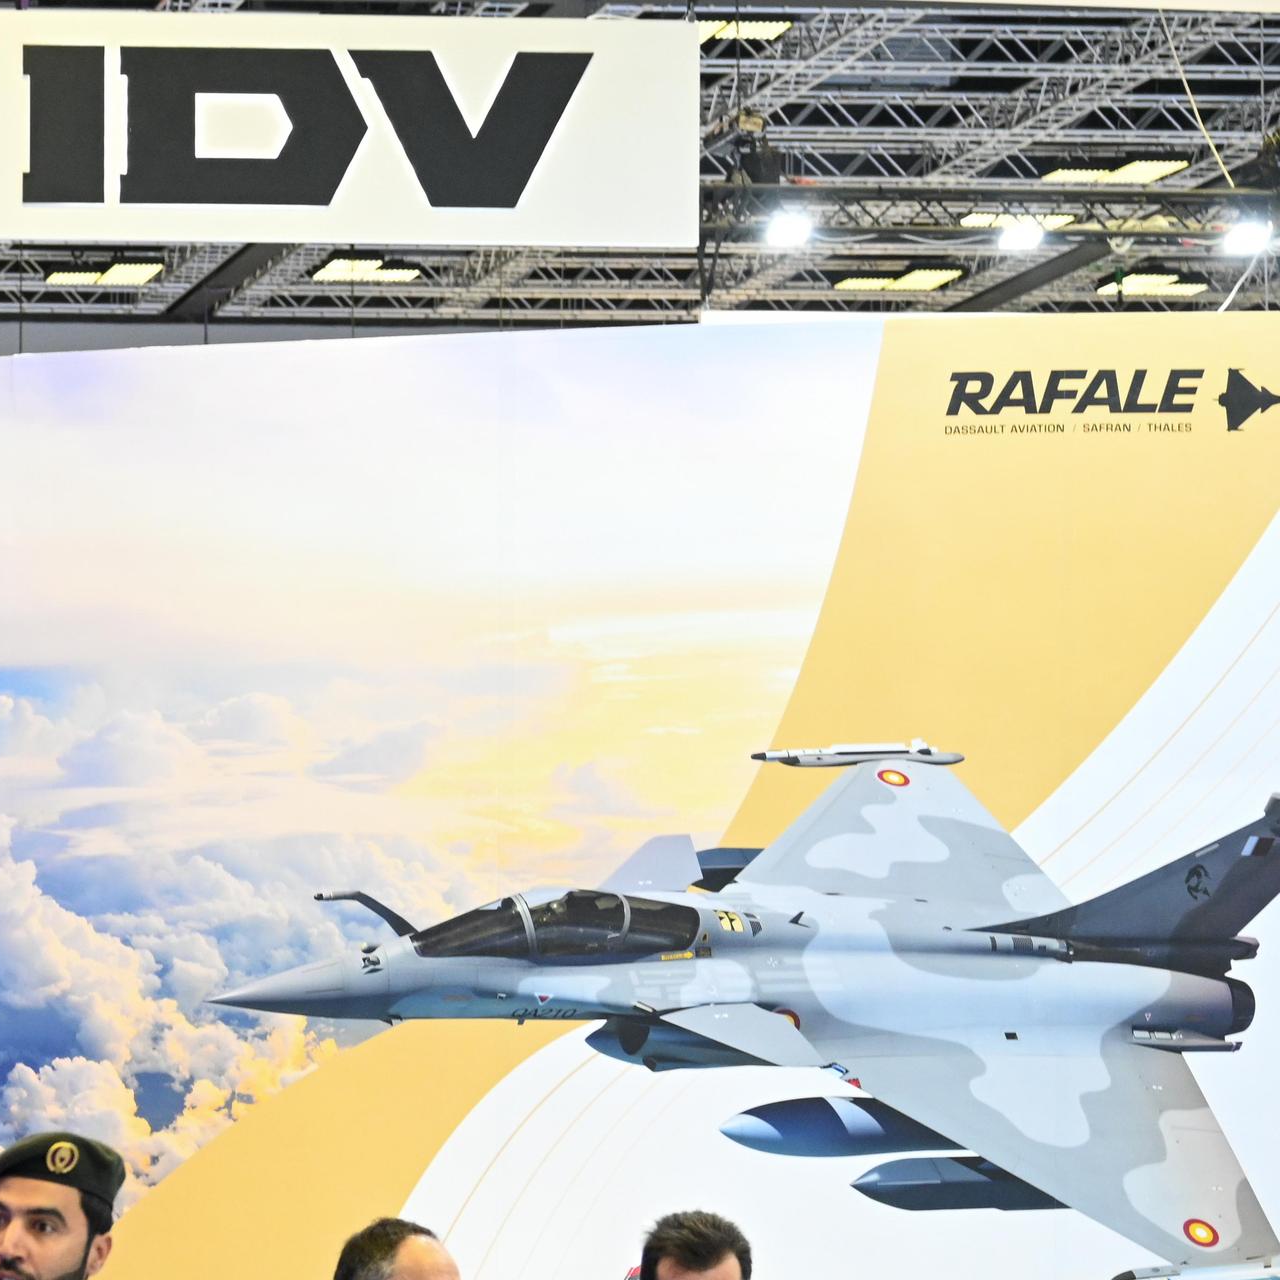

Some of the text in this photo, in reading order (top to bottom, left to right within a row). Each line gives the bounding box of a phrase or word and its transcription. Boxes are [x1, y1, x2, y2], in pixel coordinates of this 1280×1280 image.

[22, 44, 594, 208] IDV
[946, 368, 1206, 416] RAFALE
[944, 424, 1006, 436] DASSAULT
[1010, 423, 1065, 434] AVIATION
[1082, 423, 1132, 434] SAFRAN
[1147, 422, 1193, 433] THALES
